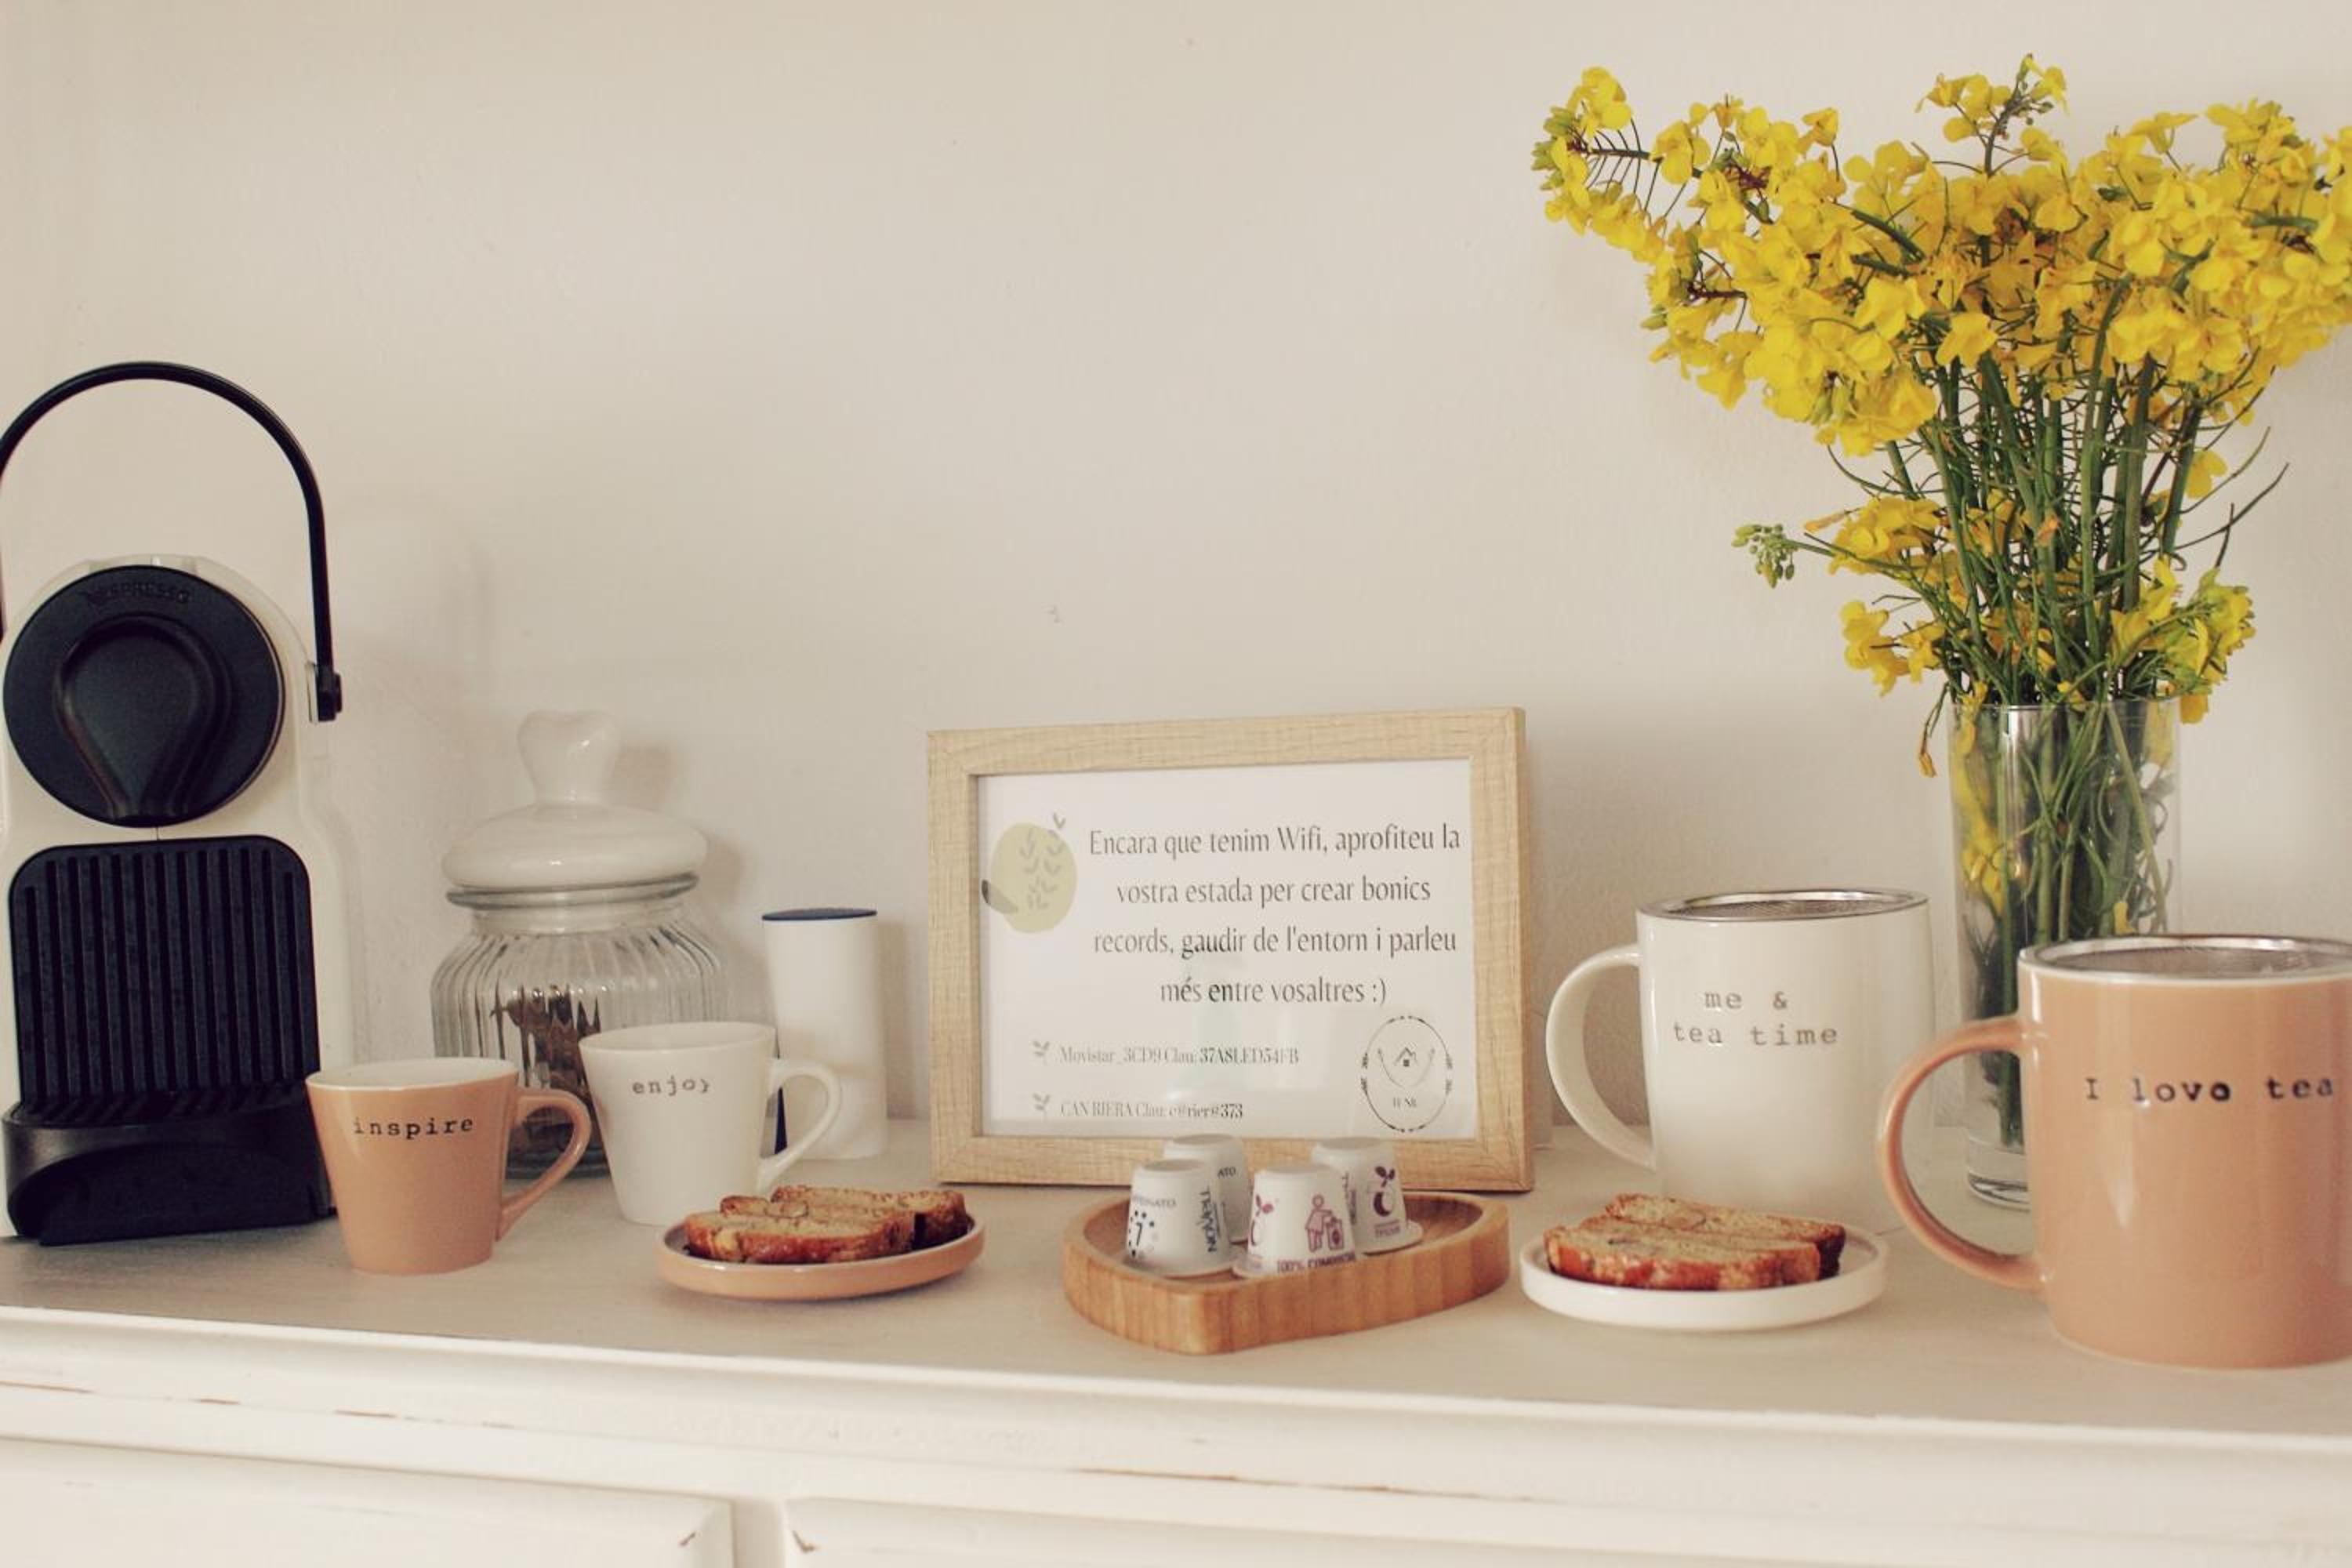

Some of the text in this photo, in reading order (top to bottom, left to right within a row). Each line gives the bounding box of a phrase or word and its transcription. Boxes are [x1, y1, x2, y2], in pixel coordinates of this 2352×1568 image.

[1090, 822, 1461, 861] Encara que tenim Wifi, aprofiteu la
[1116, 874, 1432, 909] vostra estada per crear bonics
[1094, 924, 1457, 960] records, gaudir de l'entorn i parleu
[1161, 976, 1203, 1002] més
[1208, 981, 1264, 1002] entre
[1270, 975, 1366, 1003] vosaltres
[1704, 990, 1788, 1010] me &
[1673, 1022, 1838, 1047] tea time
[2085, 1077, 2099, 1100] I
[2267, 1075, 2335, 1100] tea
[354, 1117, 473, 1140] inspire
